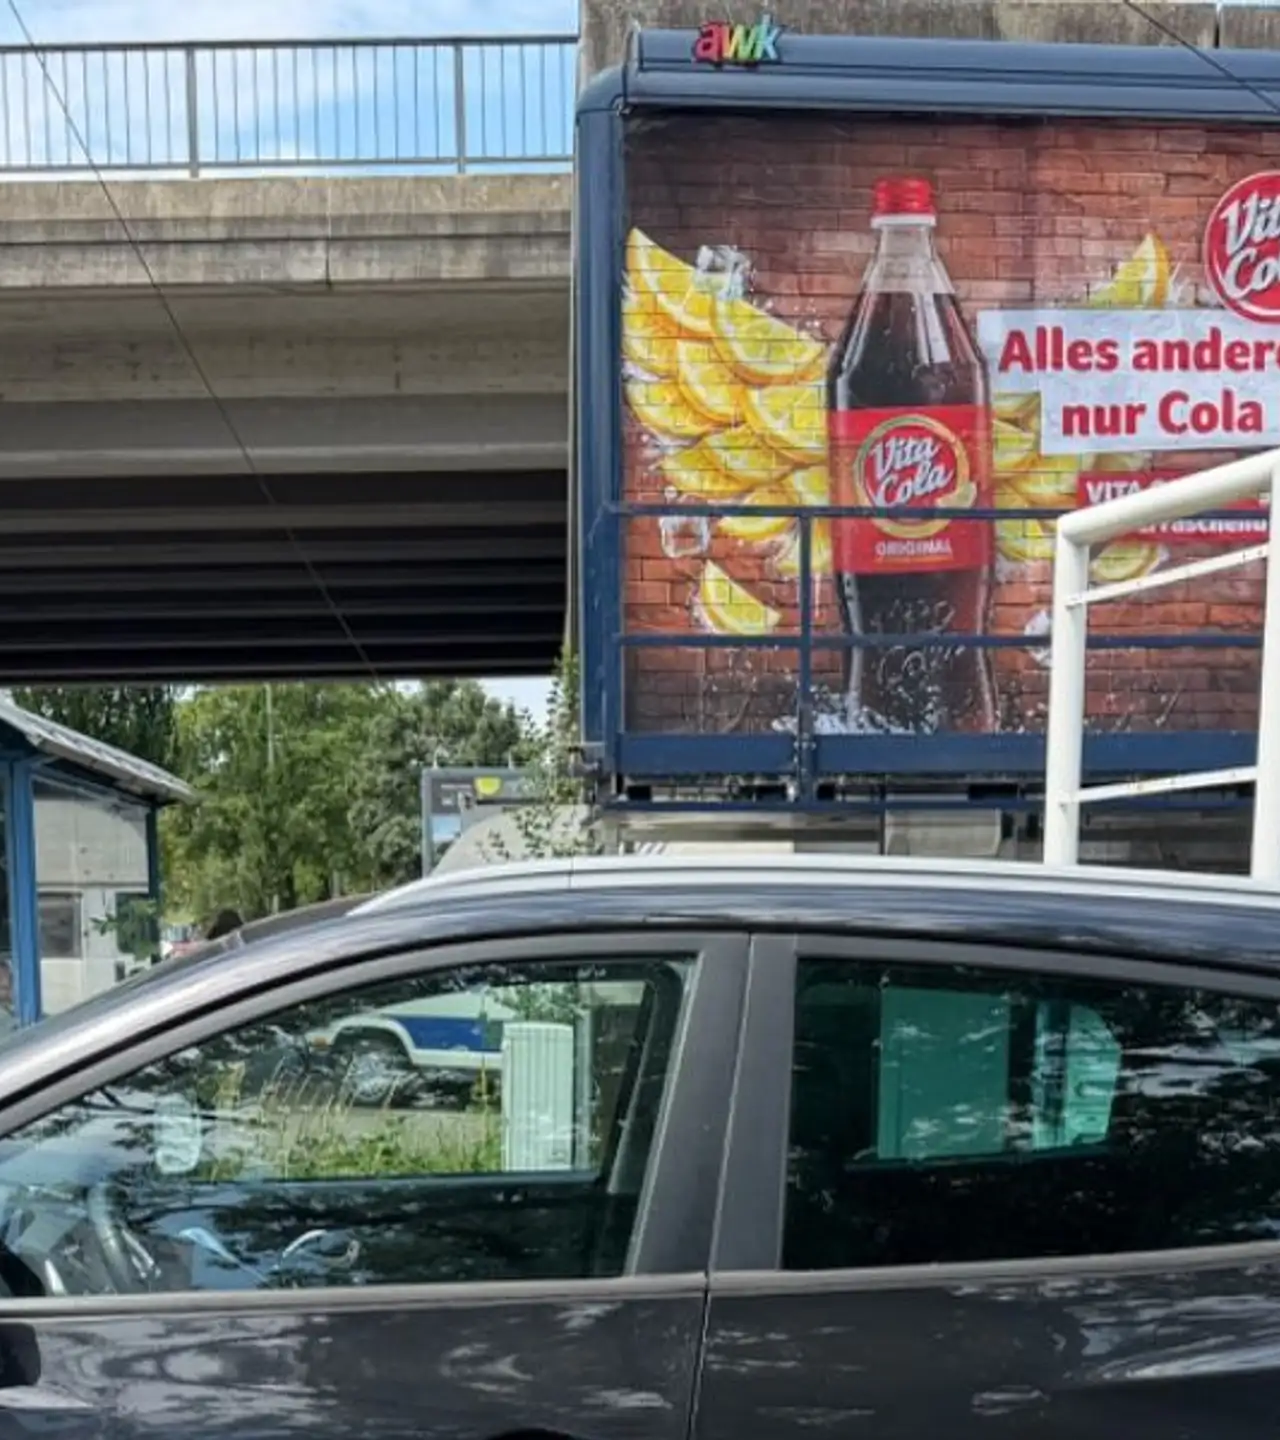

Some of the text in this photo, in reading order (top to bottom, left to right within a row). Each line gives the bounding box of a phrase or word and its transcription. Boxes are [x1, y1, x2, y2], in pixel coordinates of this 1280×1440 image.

[693, 14, 780, 62] awk
[998, 325, 1118, 372] Alles
[1061, 388, 1263, 437] nur Cola
[873, 436, 940, 480] Vita
[875, 462, 953, 507] Cola
